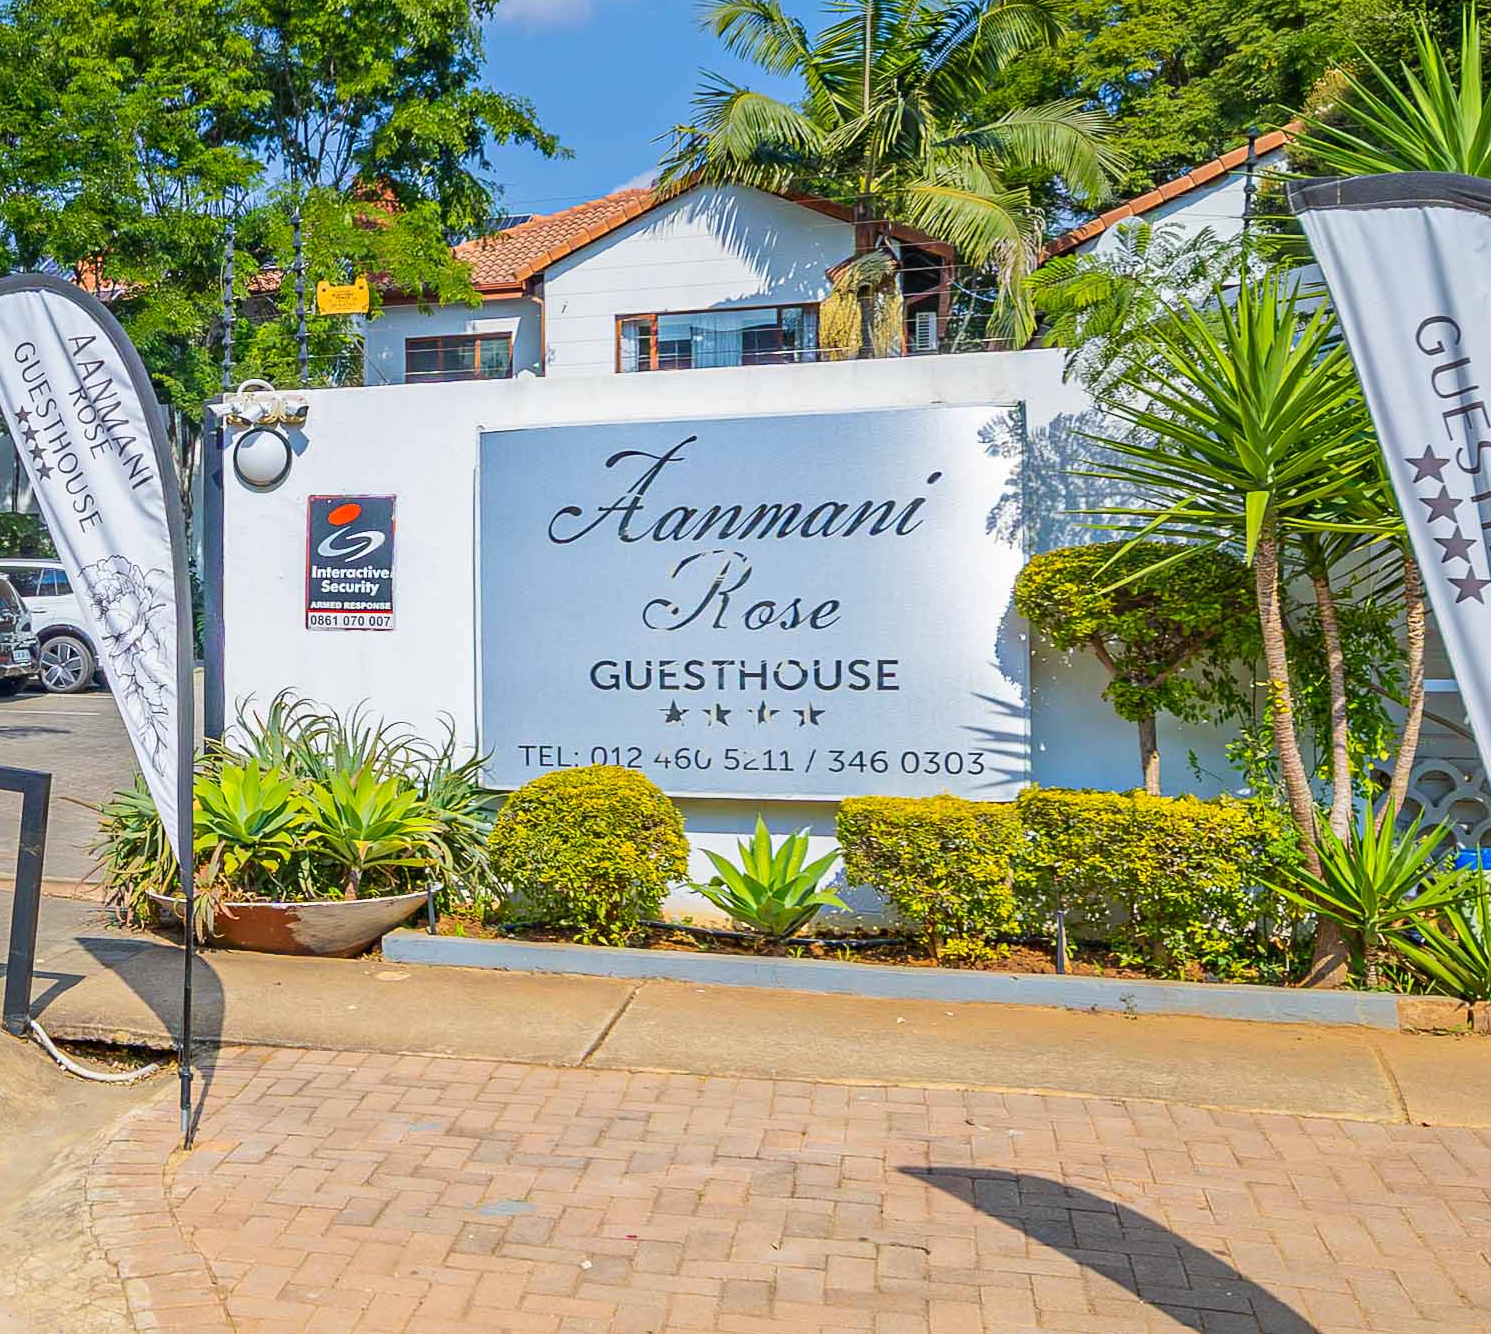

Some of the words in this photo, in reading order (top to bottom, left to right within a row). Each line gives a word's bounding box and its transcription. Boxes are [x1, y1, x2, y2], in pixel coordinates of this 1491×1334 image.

[68, 335, 154, 490] AANMANI
[68, 385, 114, 459] ROSE
[14, 341, 104, 533] GUESTHOUSE
[548, 435, 942, 543] Aanmani
[311, 565, 390, 579] Interactive
[321, 579, 380, 596] Security
[310, 601, 342, 609] ARMED
[343, 601, 391, 610] RESPONSE
[642, 549, 842, 631] Rose
[310, 614, 338, 626] 0861
[343, 615, 365, 626] 070
[369, 616, 391, 627] 007
[590, 659, 899, 691] GUESTHOUSE
[518, 745, 579, 767] TEL:
[590, 746, 642, 768] 012
[653, 748, 712, 770] 460
[724, 748, 794, 771] 5211
[805, 748, 817, 773] /
[827, 750, 889, 774] 346
[900, 750, 985, 775] 0303
